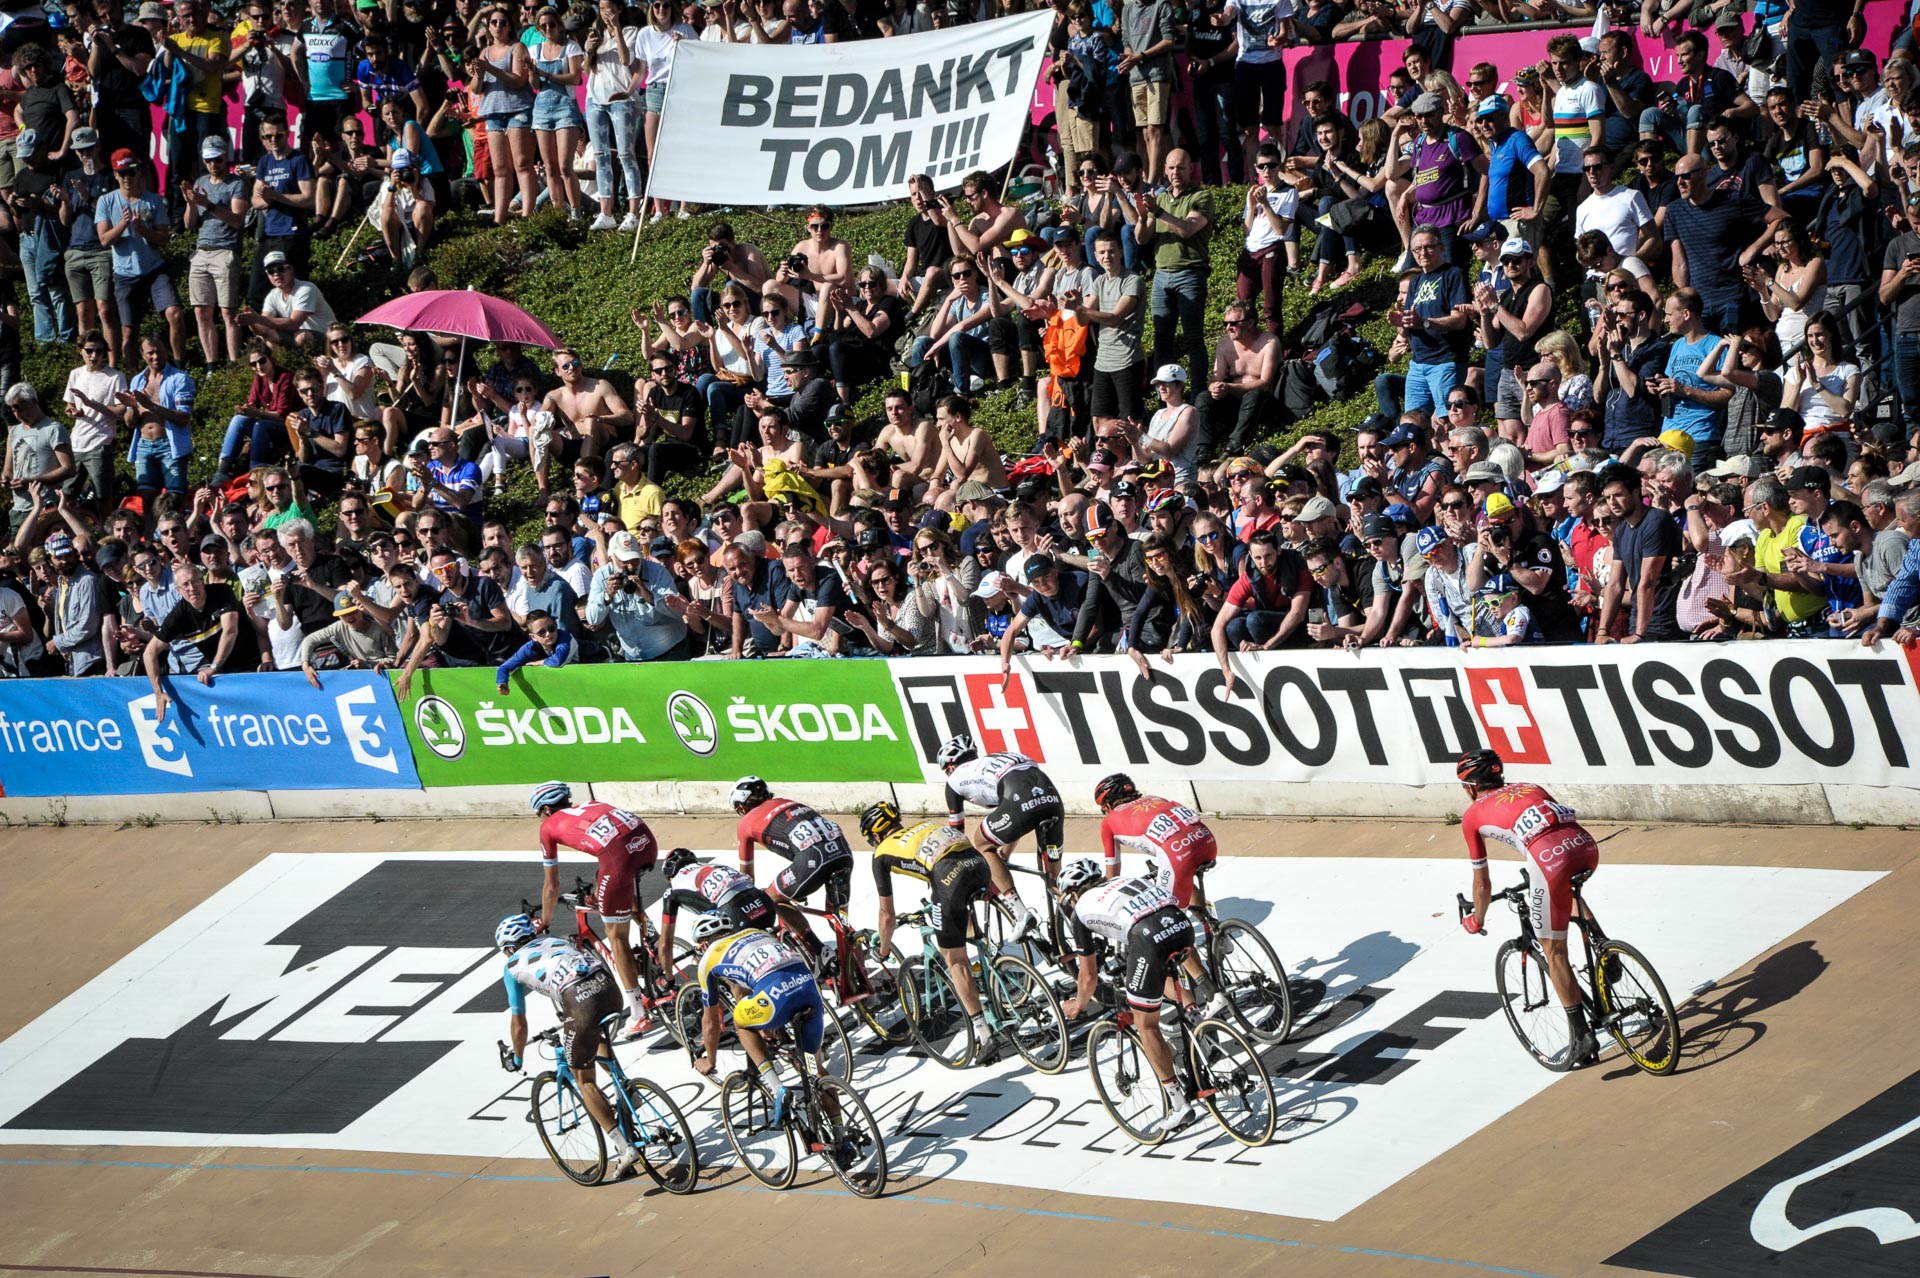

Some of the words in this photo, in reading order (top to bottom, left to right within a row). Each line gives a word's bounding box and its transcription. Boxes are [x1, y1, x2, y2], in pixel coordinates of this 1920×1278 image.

[720, 35, 1034, 128] BEDANKT
[760, 131, 912, 192] TOM
[925, 113, 989, 178] !!!!
[208, 704, 331, 747] france
[474, 701, 647, 746] ŠKODA
[727, 696, 899, 743] ŠKODA
[1032, 665, 1390, 767] TISSOT
[1530, 657, 1910, 769] TISSOT
[0, 711, 122, 753] france
[1021, 795, 1060, 812] RENSON
[590, 816, 615, 840] 157
[793, 824, 813, 842] 63
[988, 813, 1011, 830] Sunweb
[1149, 815, 1174, 838] 168
[1516, 808, 1542, 836] 163
[772, 840, 790, 850] TREK
[921, 837, 941, 857] 95
[1170, 826, 1210, 852] Cofidis
[1538, 832, 1593, 863] Cofidis
[598, 874, 611, 913] KATUSHA
[741, 898, 764, 914] UAE
[1122, 896, 1149, 917] 144
[1530, 887, 1545, 930] Cofidis
[1153, 920, 1191, 944] RENSON
[746, 947, 770, 969] 178
[551, 965, 571, 986] 131
[782, 973, 813, 993] Baloise
[1128, 957, 1147, 992] Sunweb
